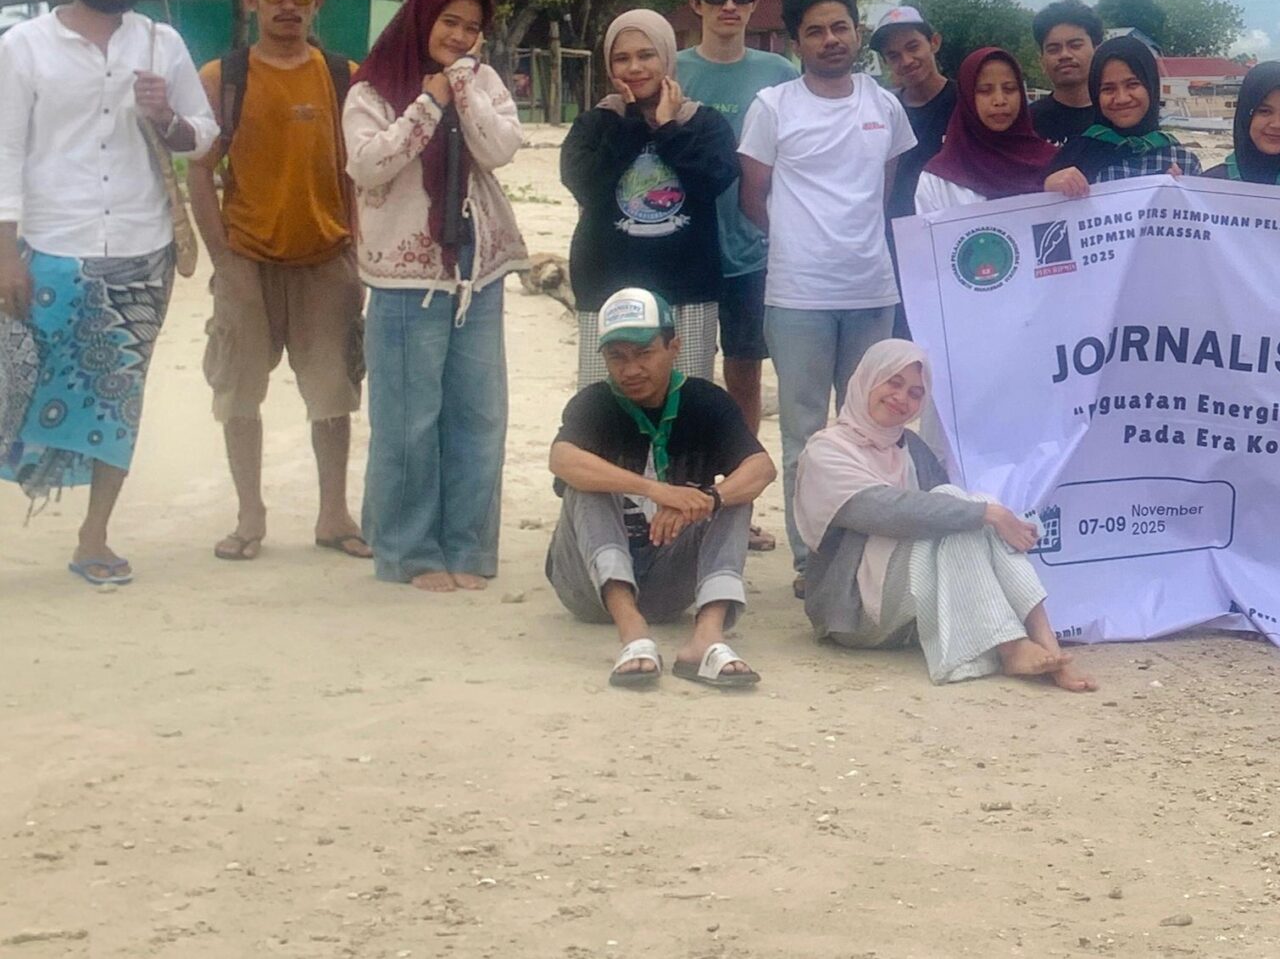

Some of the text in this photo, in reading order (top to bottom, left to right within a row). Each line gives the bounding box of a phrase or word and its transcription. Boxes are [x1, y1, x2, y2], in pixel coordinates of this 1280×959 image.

[1078, 211, 1133, 231] BIDANG
[1172, 209, 1250, 228] HIMPUNAN
[1080, 228, 1136, 249] HIPMIN
[1082, 249, 1116, 266] 2025
[1197, 394, 1279, 425] Energi
[1124, 424, 1186, 444] Pada
[1196, 428, 1236, 452] Era
[1078, 504, 1204, 536] 07-09 November
[1131, 520, 1166, 536] 2025
